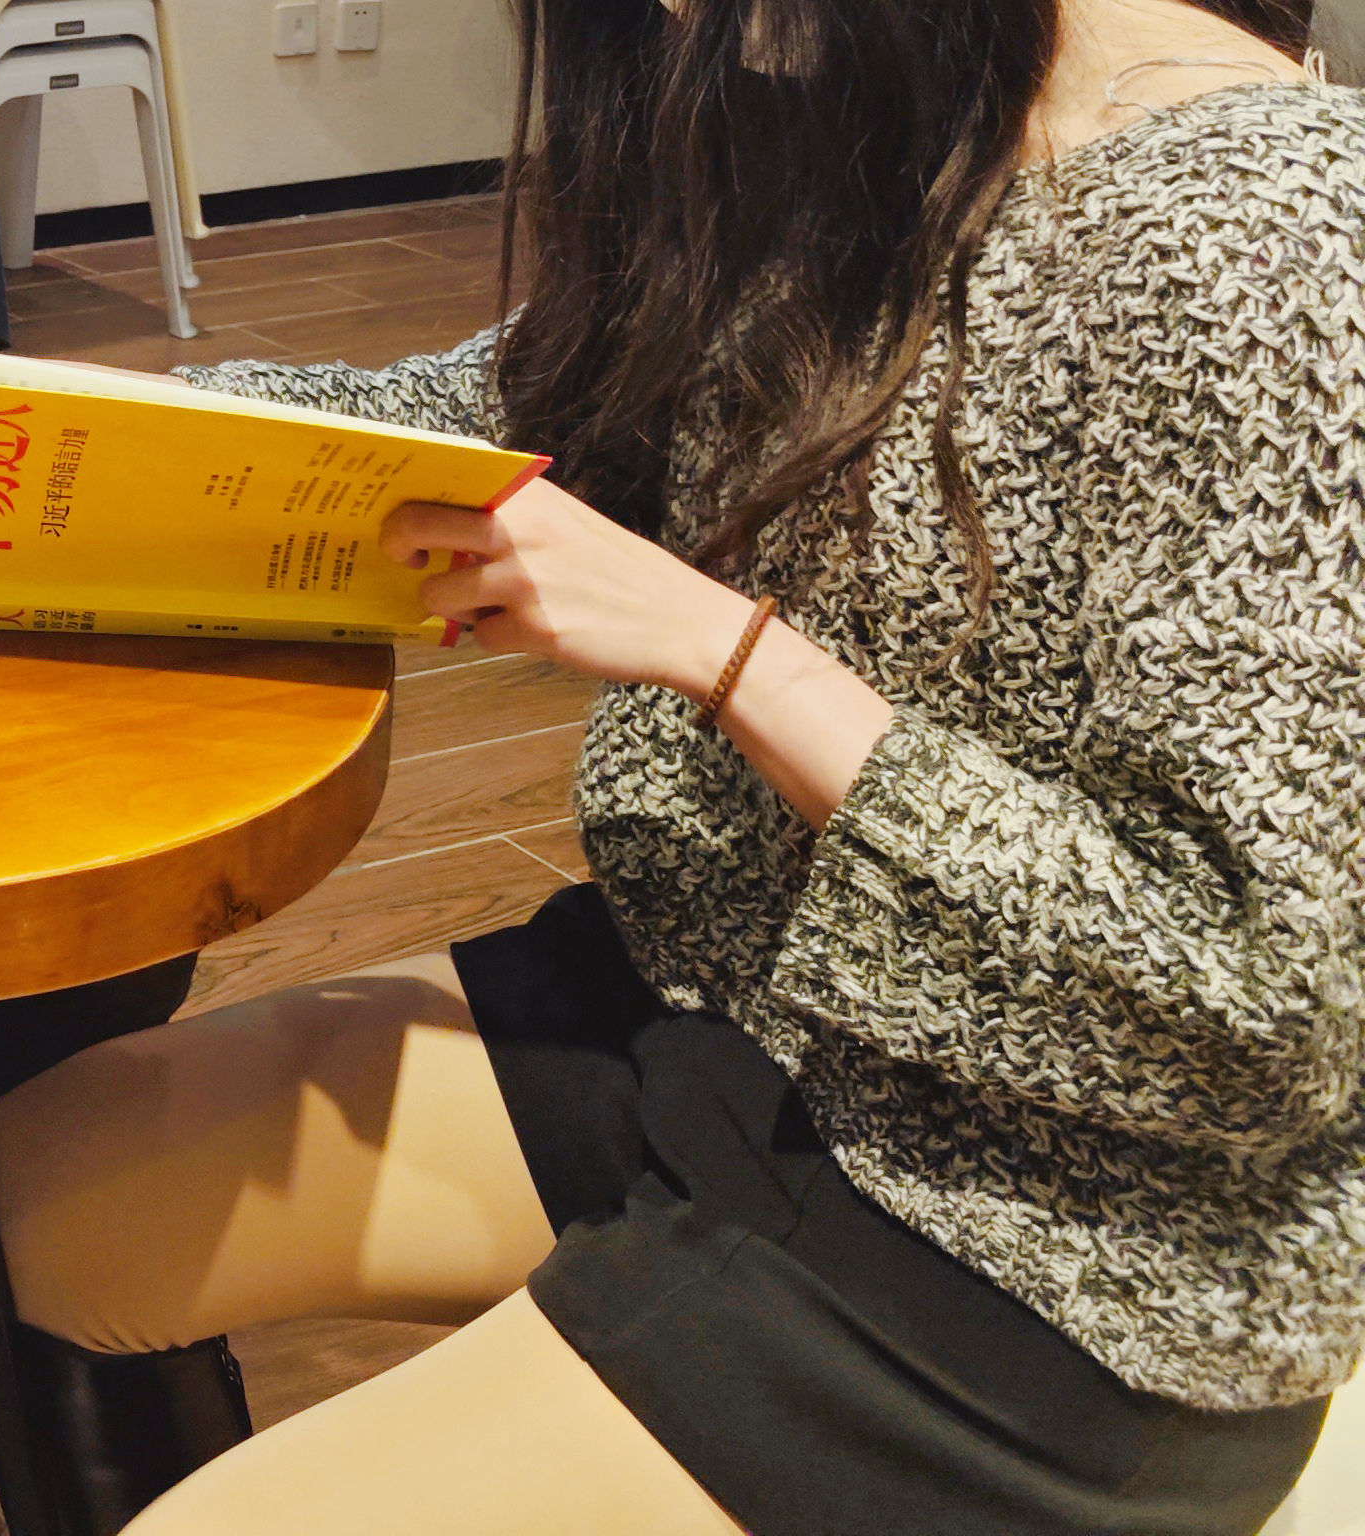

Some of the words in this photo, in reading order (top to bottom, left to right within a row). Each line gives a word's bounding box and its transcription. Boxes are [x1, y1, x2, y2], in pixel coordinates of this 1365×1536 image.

[40, 428, 90, 539] 习近平的语言力量
